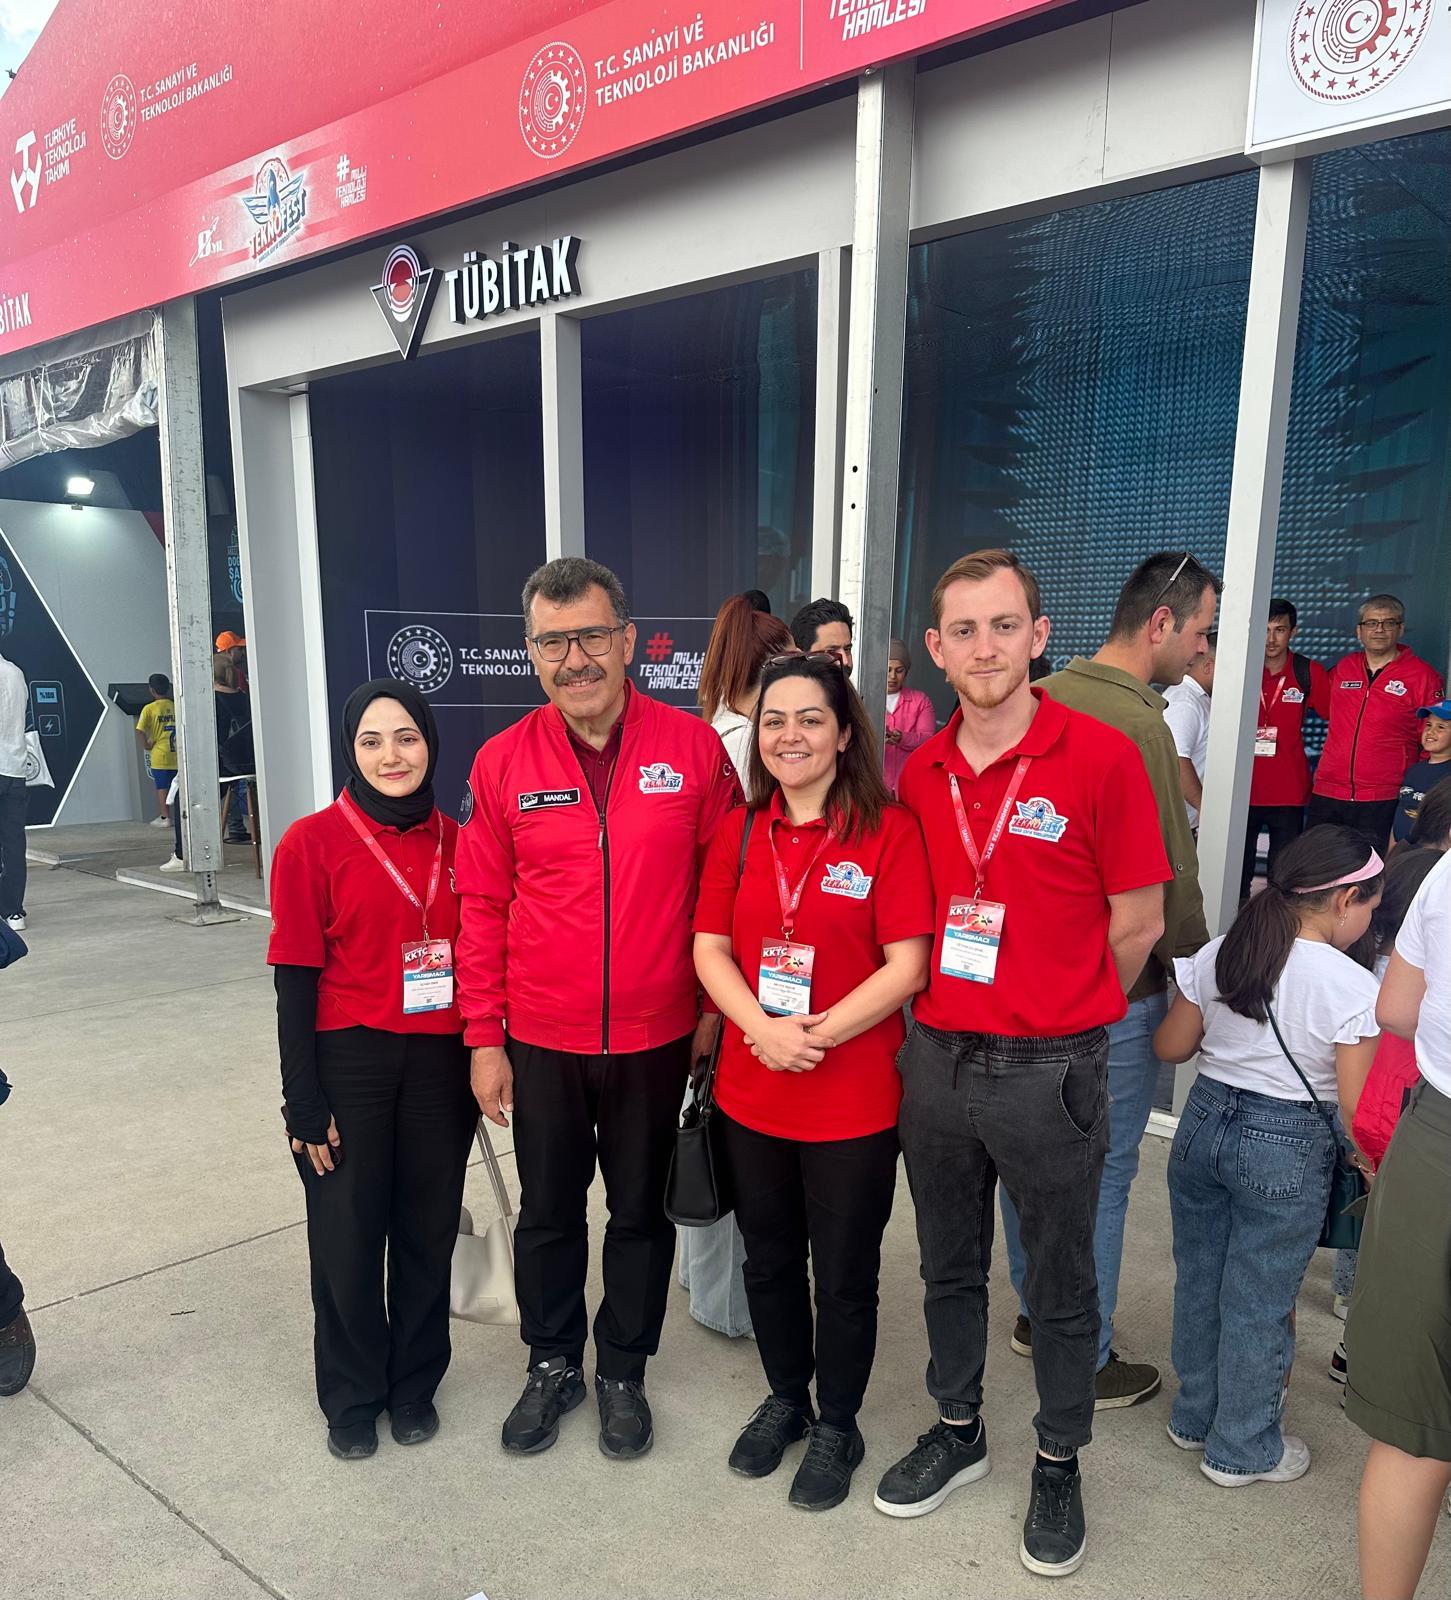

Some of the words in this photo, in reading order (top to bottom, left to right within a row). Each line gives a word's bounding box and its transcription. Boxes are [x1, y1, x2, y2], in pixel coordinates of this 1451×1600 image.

[594, 55, 620, 80] T.C.
[623, 26, 679, 70] SANAYİ
[683, 19, 704, 45] VE
[595, 56, 678, 107] TEKNOLOJİ
[682, 21, 775, 75] BAKANLIĞI
[140, 85, 154, 103] T.C.
[155, 66, 185, 96] SANAYİ
[186, 62, 198, 80] VE
[140, 87, 185, 123] TEKNOLOJİ
[186, 64, 233, 101] BAKANLIĞI
[44, 130, 87, 167] TEKNOLOJİ
[44, 159, 70, 186] TAKIMI
[249, 188, 307, 260] TEKNOFEST
[445, 236, 577, 323] TÜBİTAK
[459, 648, 482, 660] T.C.
[460, 662, 531, 675] TEKNOLOJİ
[640, 664, 702, 677] TEKNOLOJİ
[648, 677, 700, 689] HAMLESİ
[543, 793, 573, 802] MANDAL
[949, 904, 976, 916] KKTC
[404, 947, 428, 963] KKTC
[762, 946, 788, 958] KKTC
